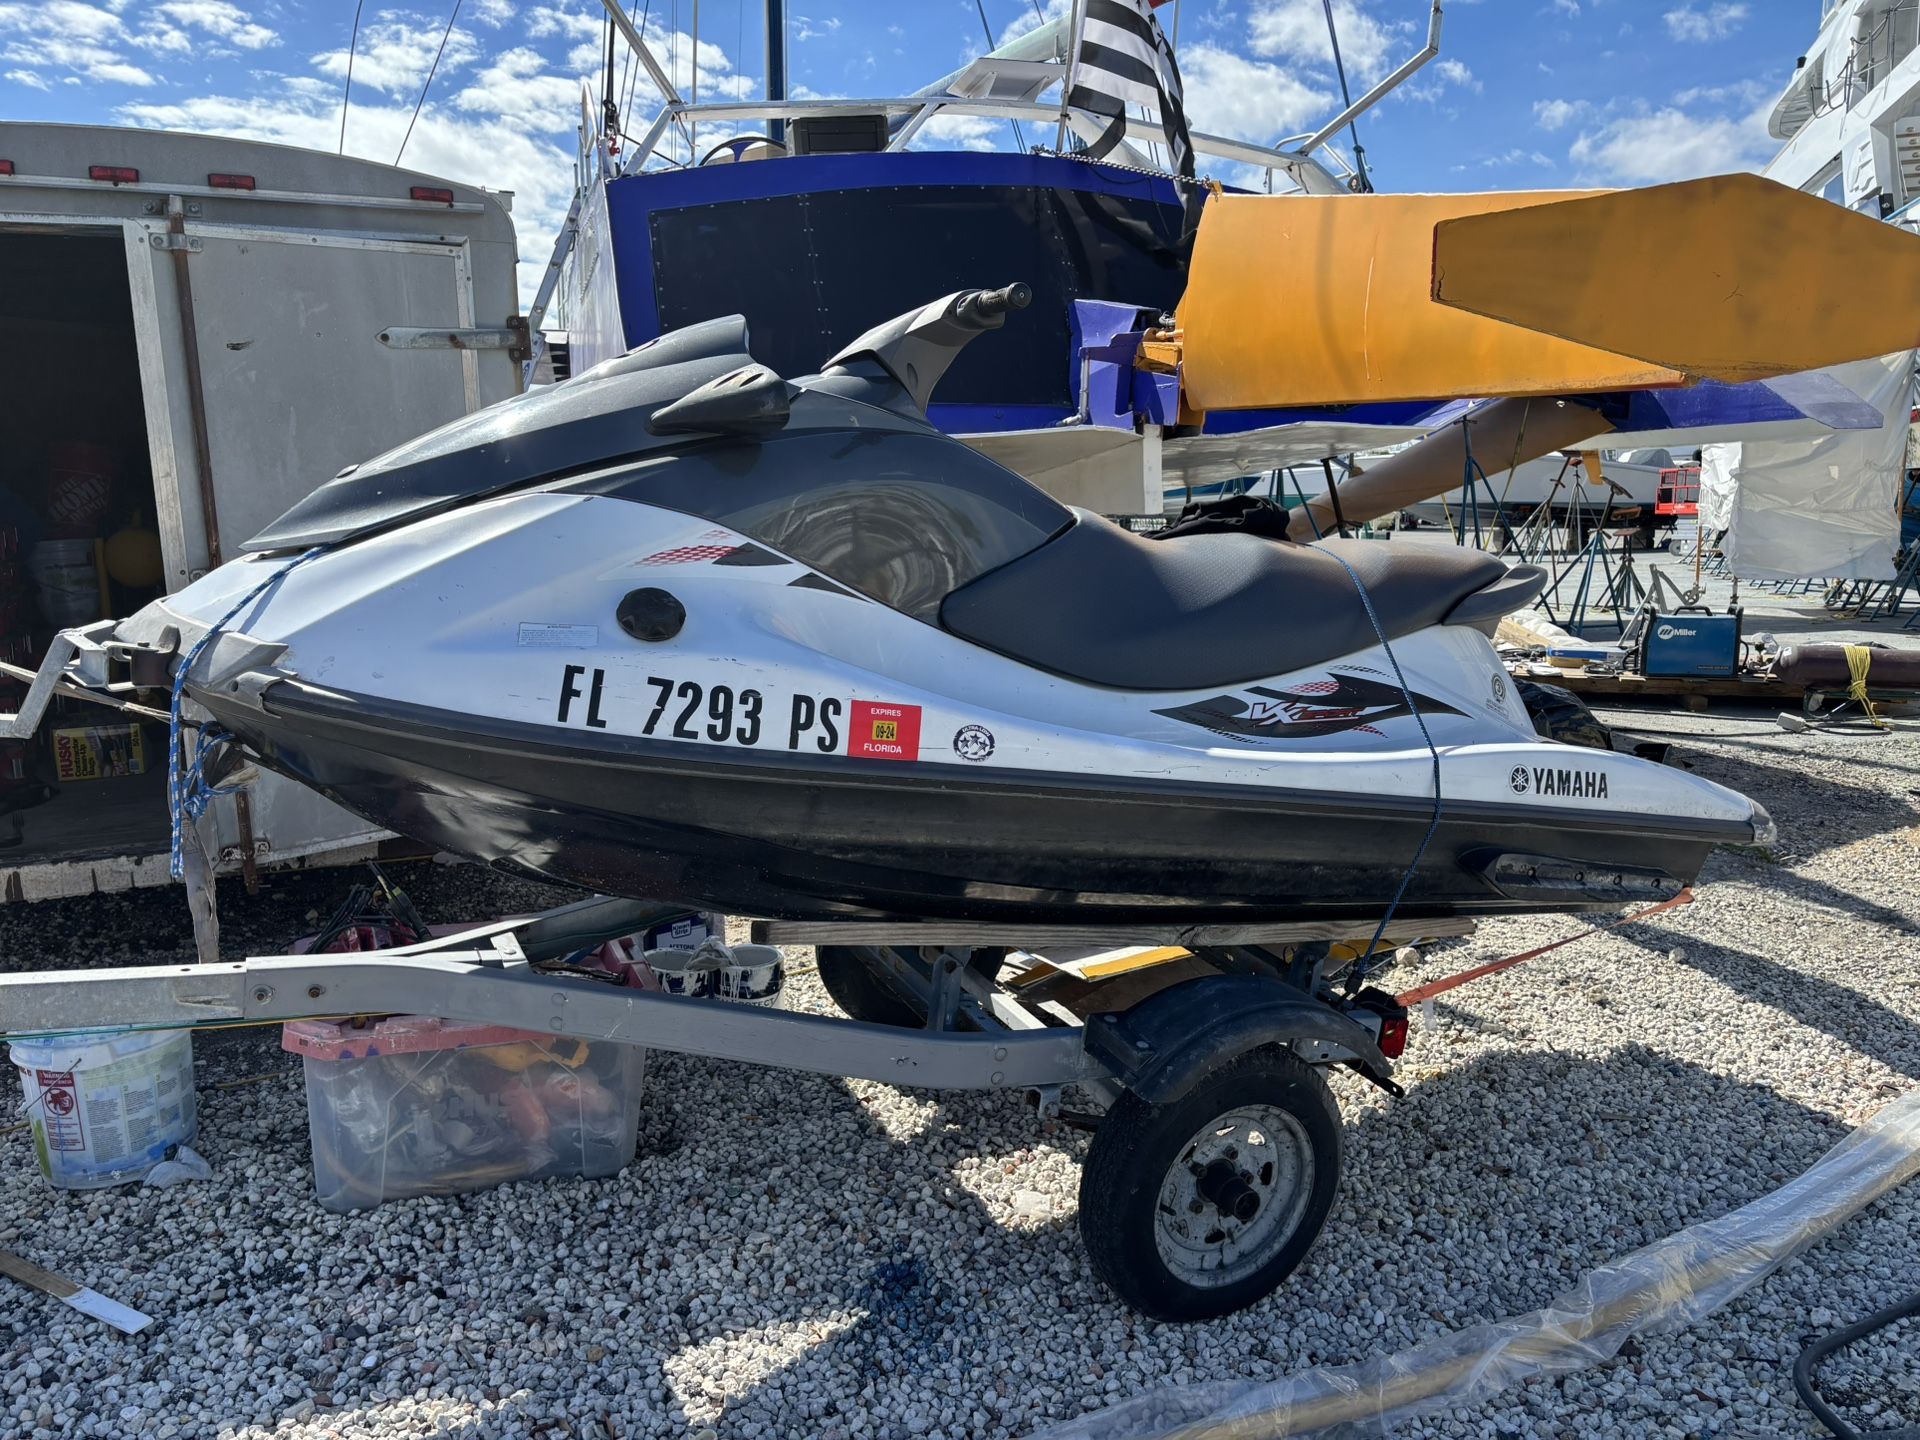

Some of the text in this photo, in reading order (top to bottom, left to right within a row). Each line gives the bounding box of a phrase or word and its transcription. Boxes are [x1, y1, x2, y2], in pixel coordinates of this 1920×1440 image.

[49, 476, 108, 520] HOME
[1674, 628, 1696, 637] Miller
[557, 664, 841, 753] FL 7293 PS
[870, 707, 902, 717] EXPIRES
[876, 724, 894, 739] 09-24
[57, 735, 74, 778] HUSKY
[72, 737, 81, 777] Contractor
[863, 743, 902, 754] FLORIDA
[1533, 767, 1608, 799] YAMAHA
